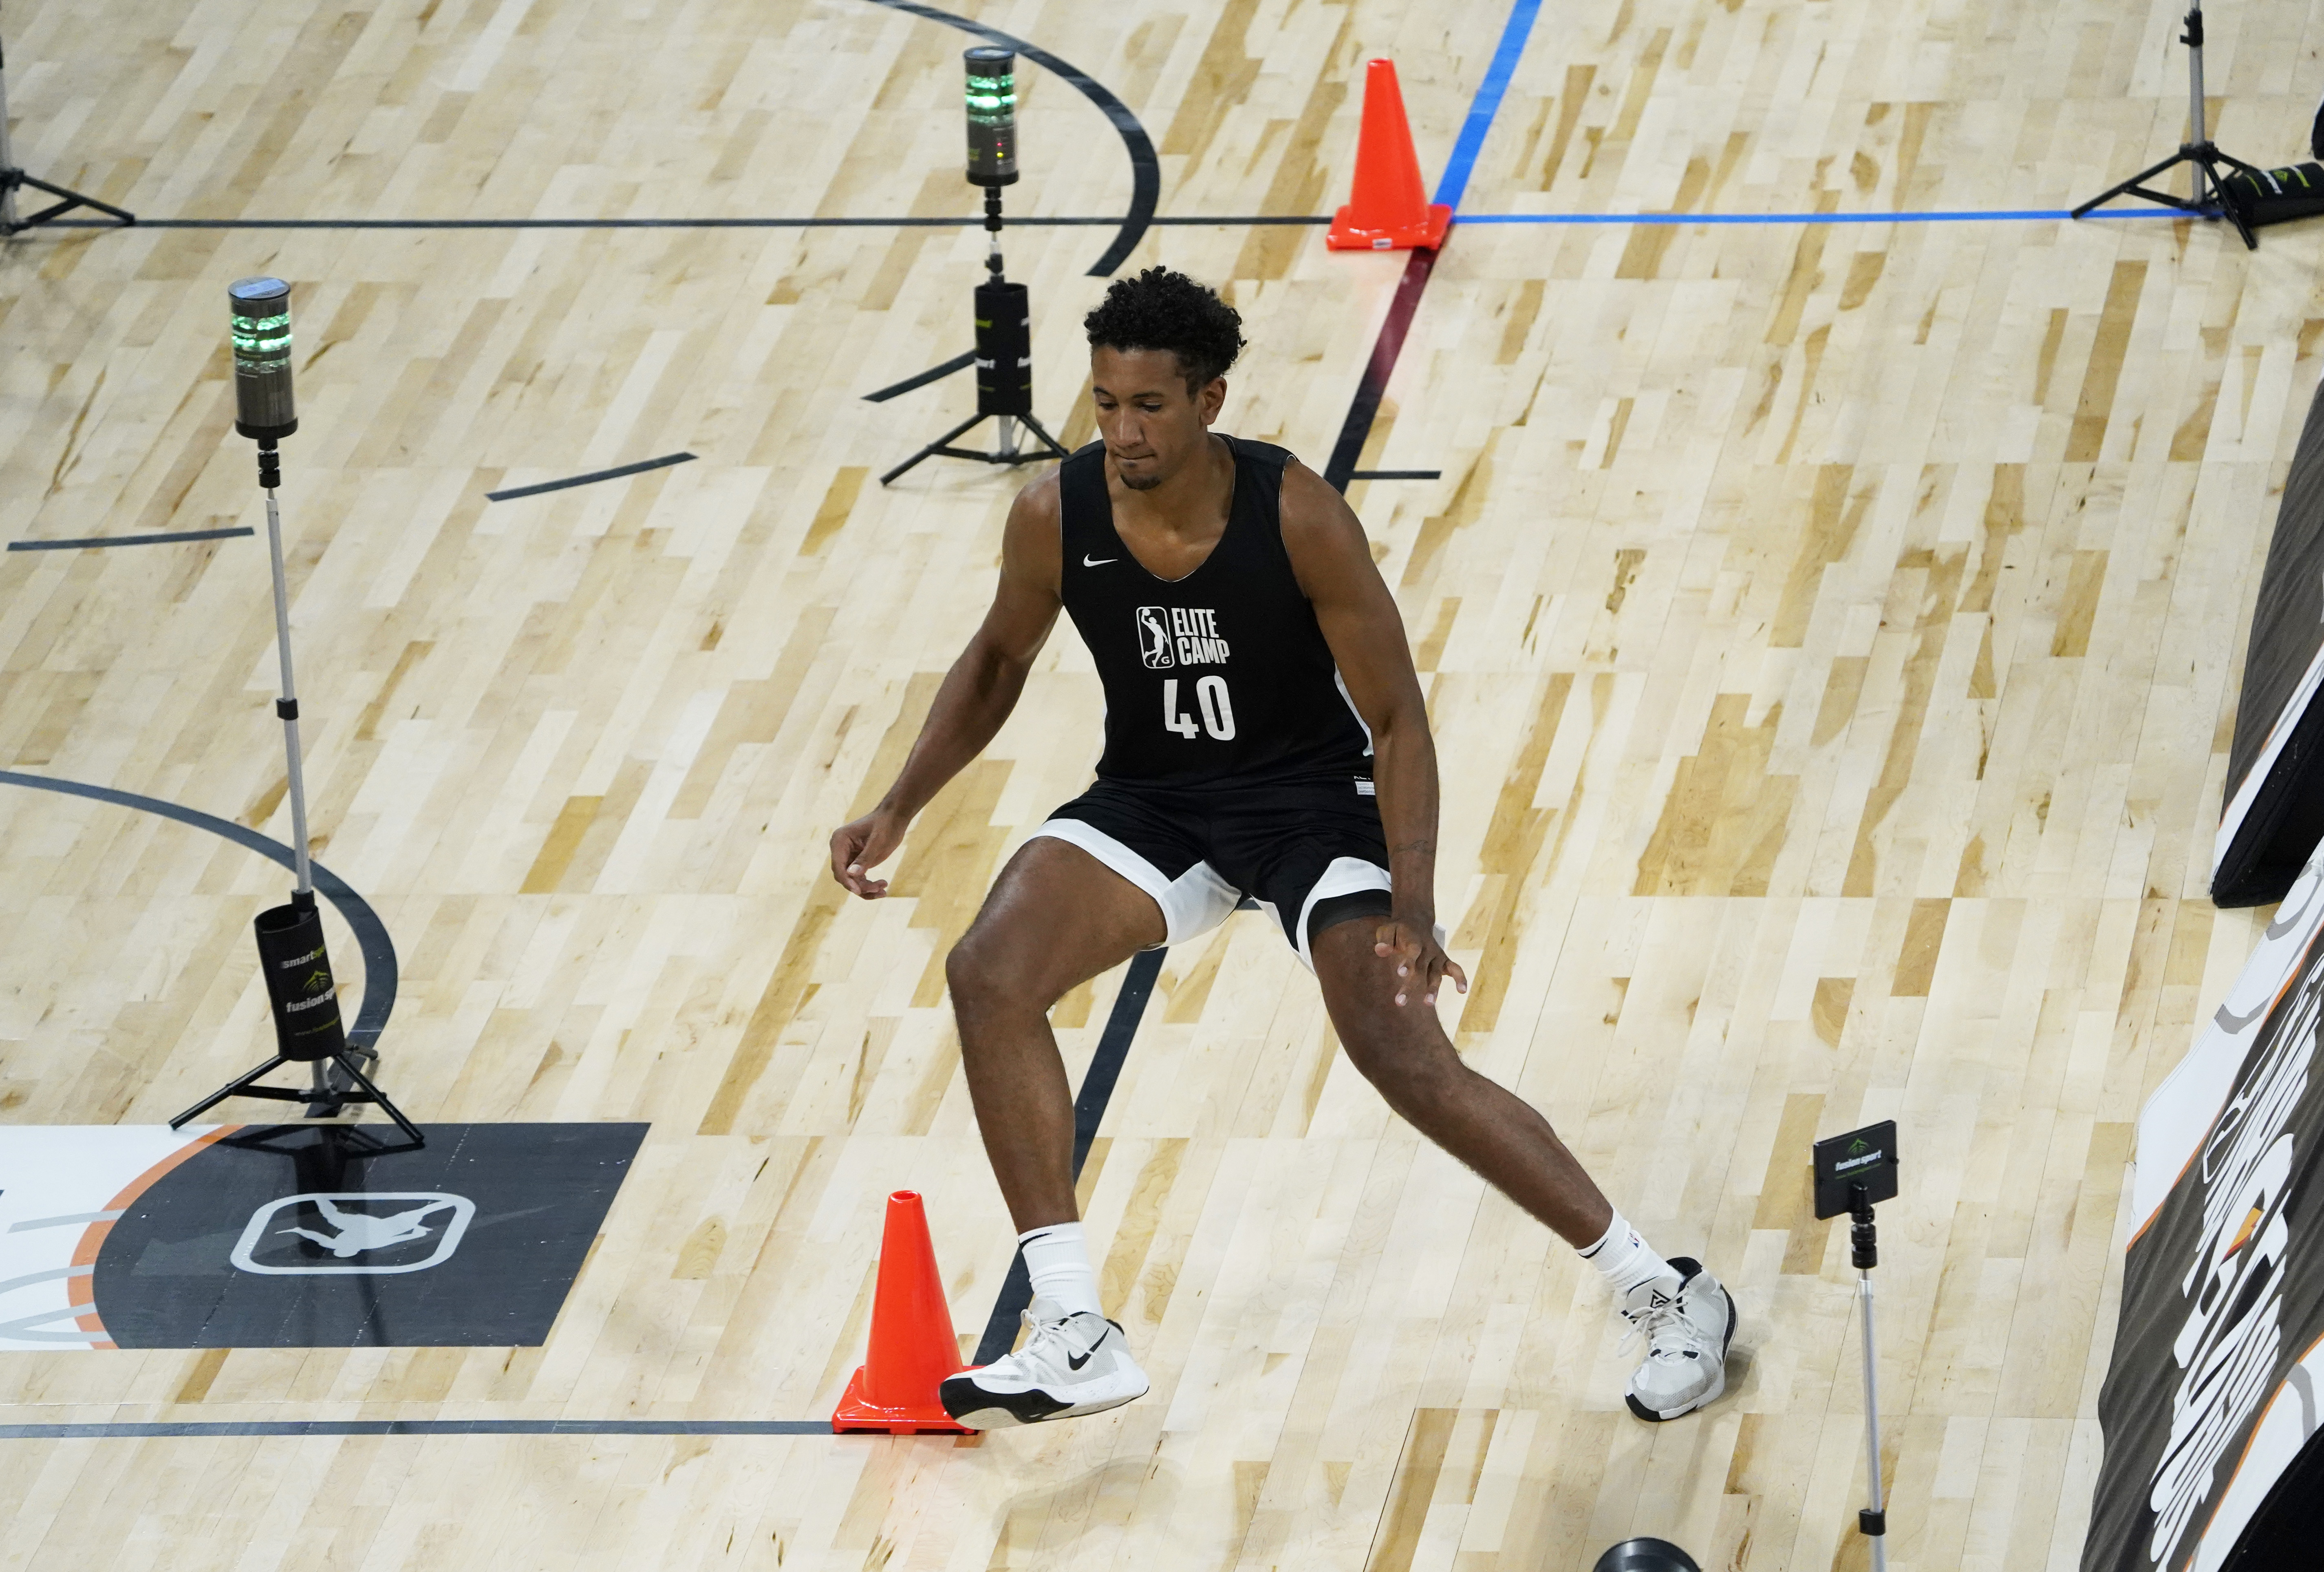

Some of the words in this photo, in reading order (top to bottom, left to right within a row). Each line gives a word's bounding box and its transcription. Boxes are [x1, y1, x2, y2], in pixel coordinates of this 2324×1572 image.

[1171, 607, 1219, 638] ELITE
[1161, 656, 1170, 664] G
[1177, 636, 1230, 665] CAMP
[1164, 675, 1236, 741] 40
